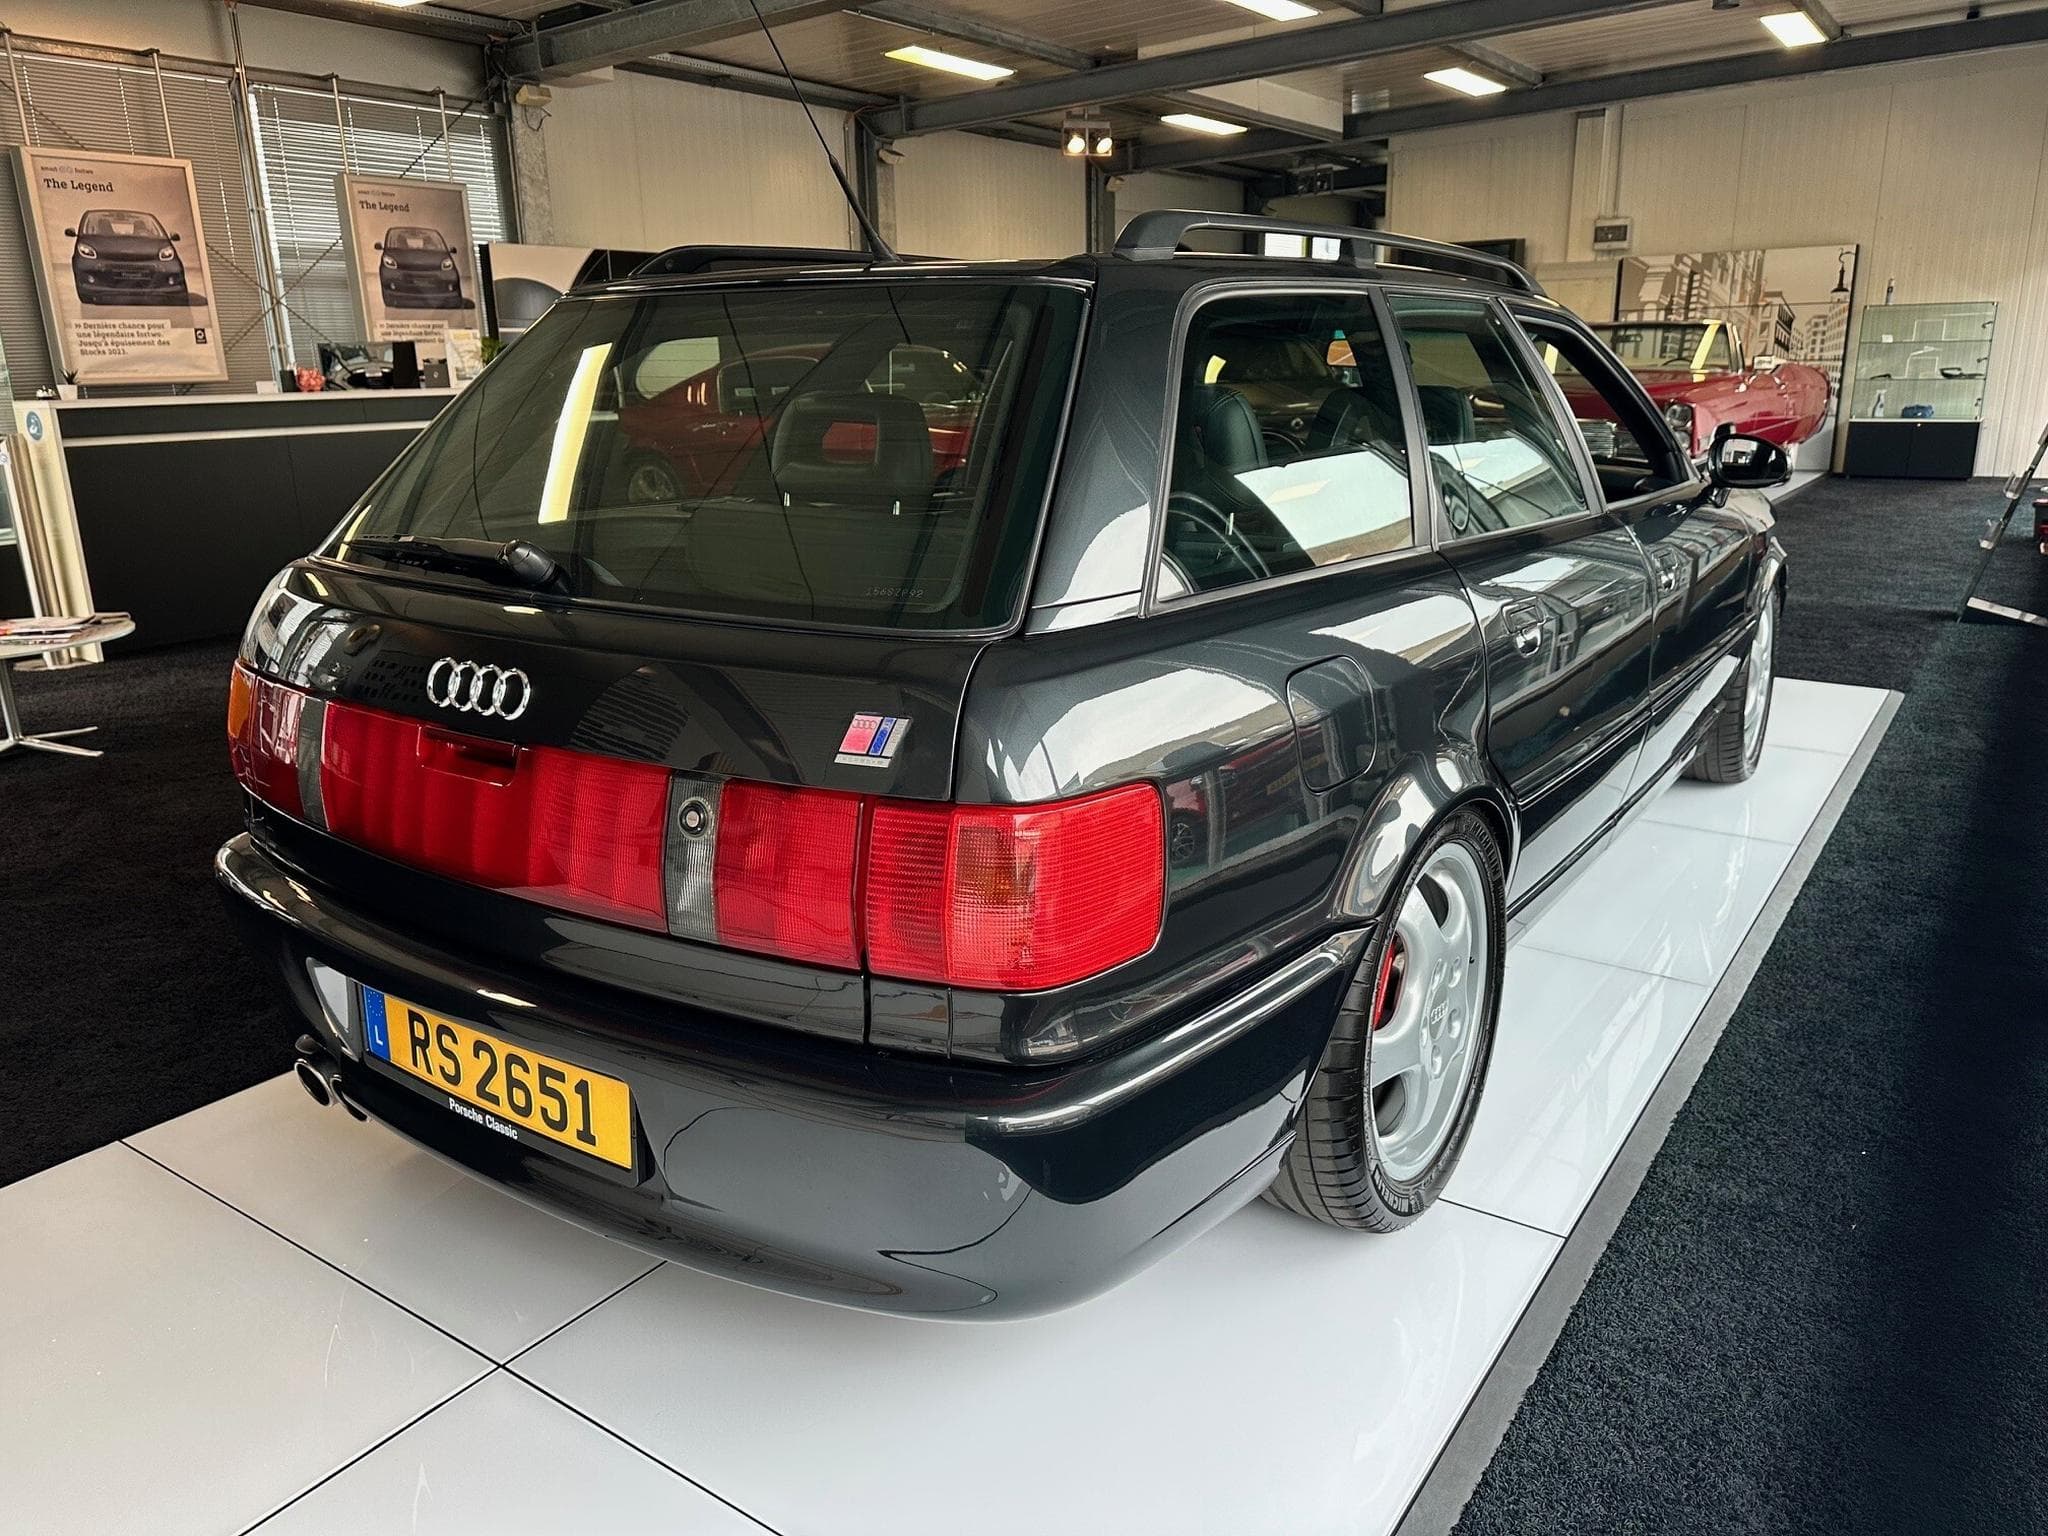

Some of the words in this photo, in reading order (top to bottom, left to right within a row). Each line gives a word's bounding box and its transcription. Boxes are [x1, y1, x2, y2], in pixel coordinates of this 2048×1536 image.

[44, 178, 68, 190] The
[71, 180, 114, 194] Legend
[359, 200, 377, 210] The
[379, 201, 410, 213] Legend
[374, 1026, 384, 1046] L
[407, 1008, 462, 1086] RS
[472, 1040, 597, 1147] 2651
[448, 1097, 484, 1125] Porsche
[485, 1114, 519, 1140] Classic
